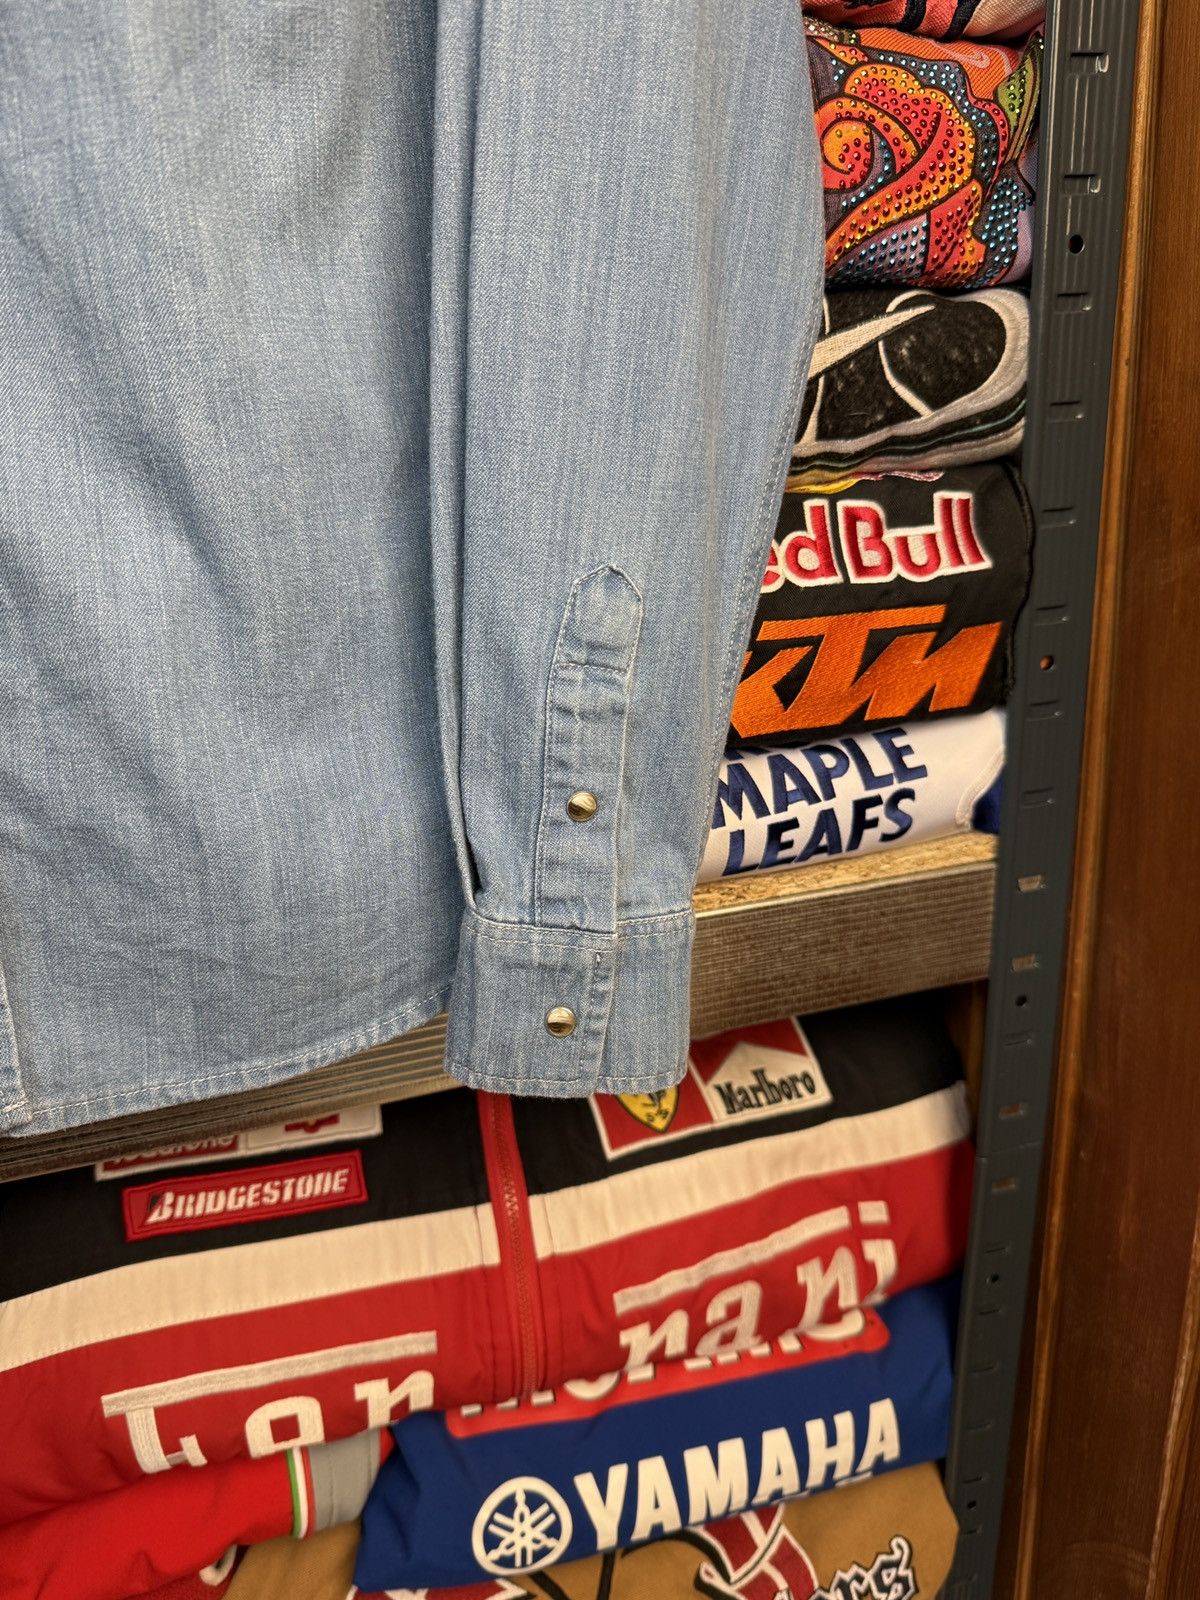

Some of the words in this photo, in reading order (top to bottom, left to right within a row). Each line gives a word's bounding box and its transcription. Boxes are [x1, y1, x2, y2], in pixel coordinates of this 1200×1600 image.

[837, 491, 992, 583] Bull
[730, 604, 1003, 739] KTM
[711, 728, 928, 830] MAPLE
[721, 788, 915, 877] LEAFS
[713, 1067, 816, 1115] Marlboro
[145, 1168, 350, 1225] BRIDGESTONE
[573, 1397, 900, 1552] YAMAHA
